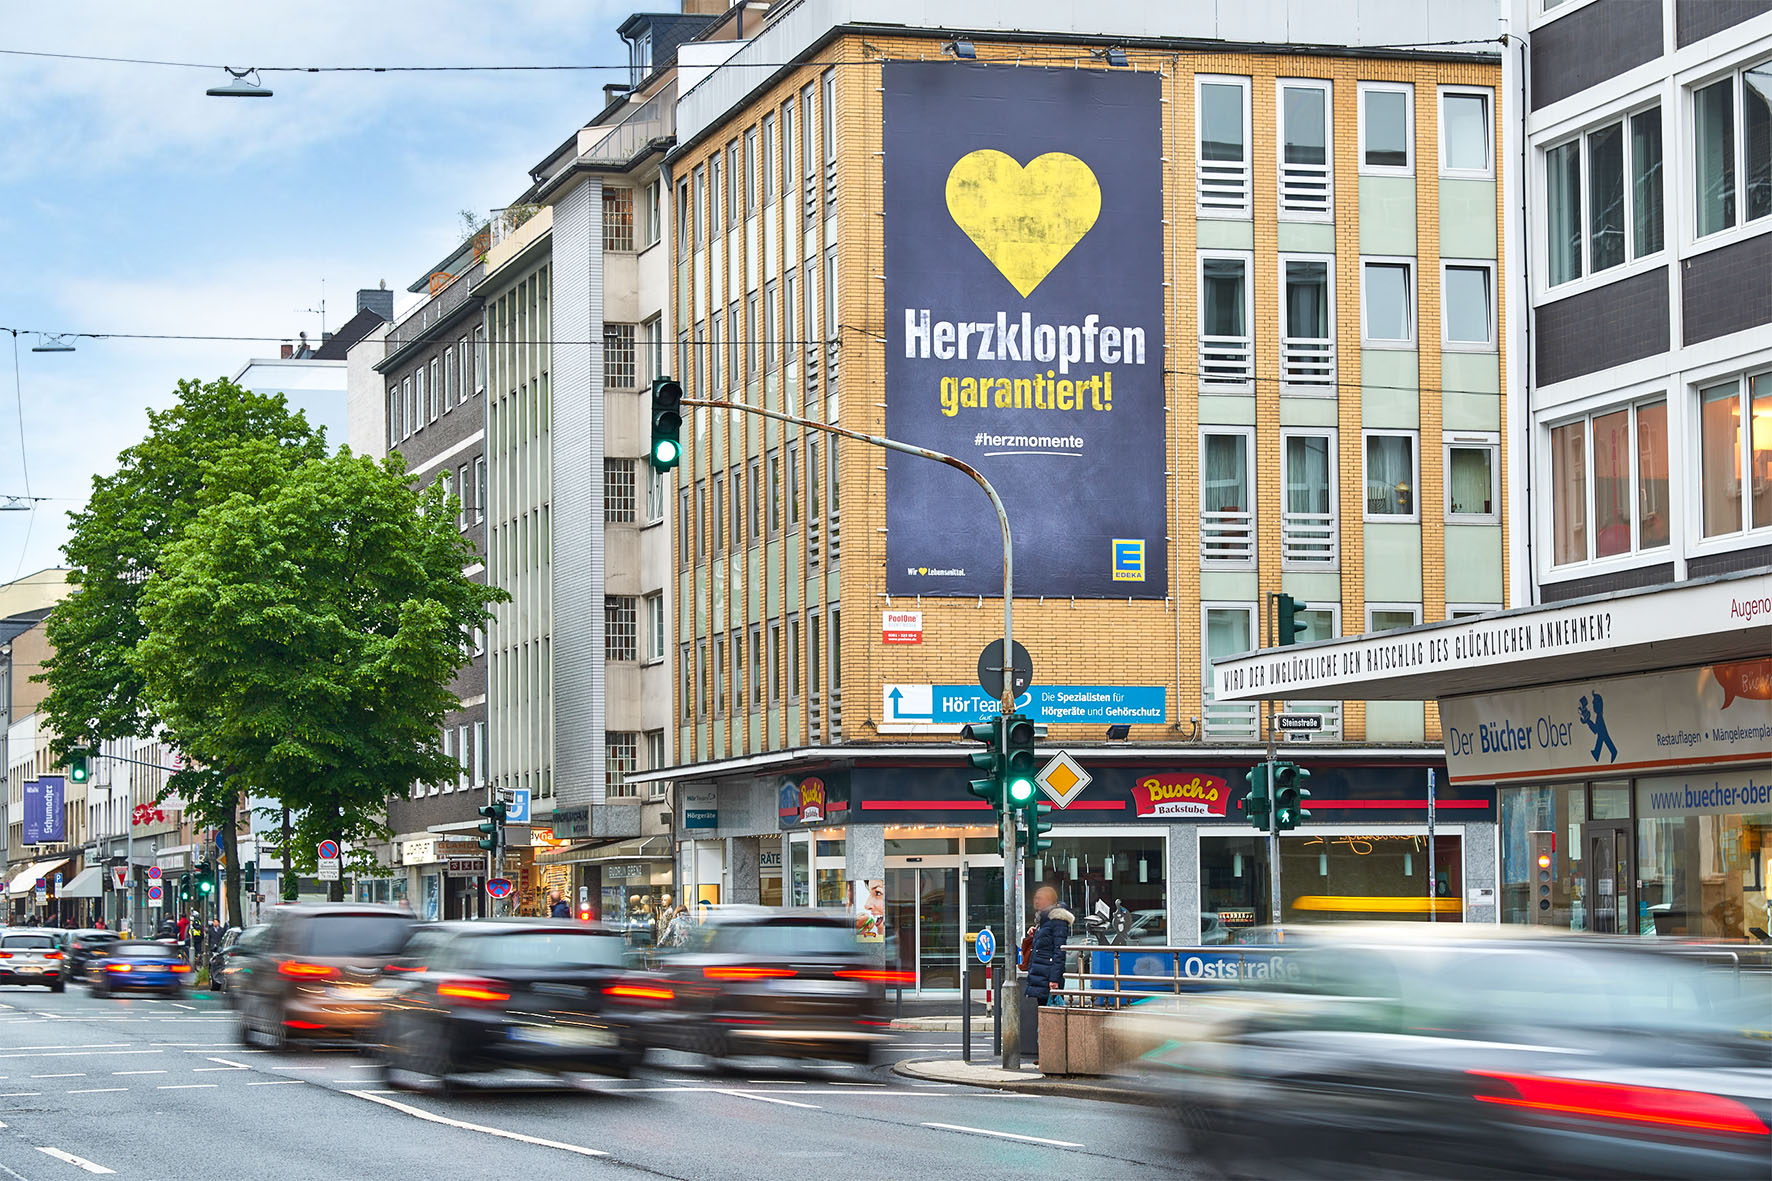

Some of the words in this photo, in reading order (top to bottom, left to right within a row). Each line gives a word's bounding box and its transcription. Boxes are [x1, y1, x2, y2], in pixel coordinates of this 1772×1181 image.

[904, 308, 1146, 374] Herzklopfen
[940, 369, 1113, 417] garantiert!
[974, 432, 1084, 448] #herzmomente
[907, 567, 918, 576] Wir
[1730, 598, 1772, 621] Augeno
[888, 614, 917, 623] PoolOne
[1224, 668, 1244, 692] WIRD
[1249, 665, 1265, 688] DER
[1270, 654, 1338, 685] UNGLÜCKLICHE
[1343, 650, 1361, 675] DEN
[1367, 642, 1423, 672] RATSCHLAG
[1430, 638, 1449, 663] DES
[1455, 625, 1532, 660] GLÜCKLICHEN
[1539, 612, 1612, 648] ANNEHMEN?
[1041, 692, 1055, 702] Die
[1057, 691, 1111, 704] Spezialisten
[1112, 691, 1125, 702] für
[1041, 705, 1085, 718] Hörgeräte
[1087, 706, 1103, 717] und
[1105, 705, 1161, 717] Gehörschutz
[1282, 718, 1318, 727] Steinstraße
[1450, 727, 1474, 756] Der
[1479, 719, 1533, 753] Bücher
[1536, 715, 1573, 748] Ober
[1656, 730, 1702, 747] Restauflagen
[1143, 777, 1219, 802] Busch's
[43, 785, 54, 834] Schumacher
[686, 812, 716, 820] Hörgeräte
[1159, 804, 1205, 815] Backstube
[1184, 956, 1300, 980] Oststraße
